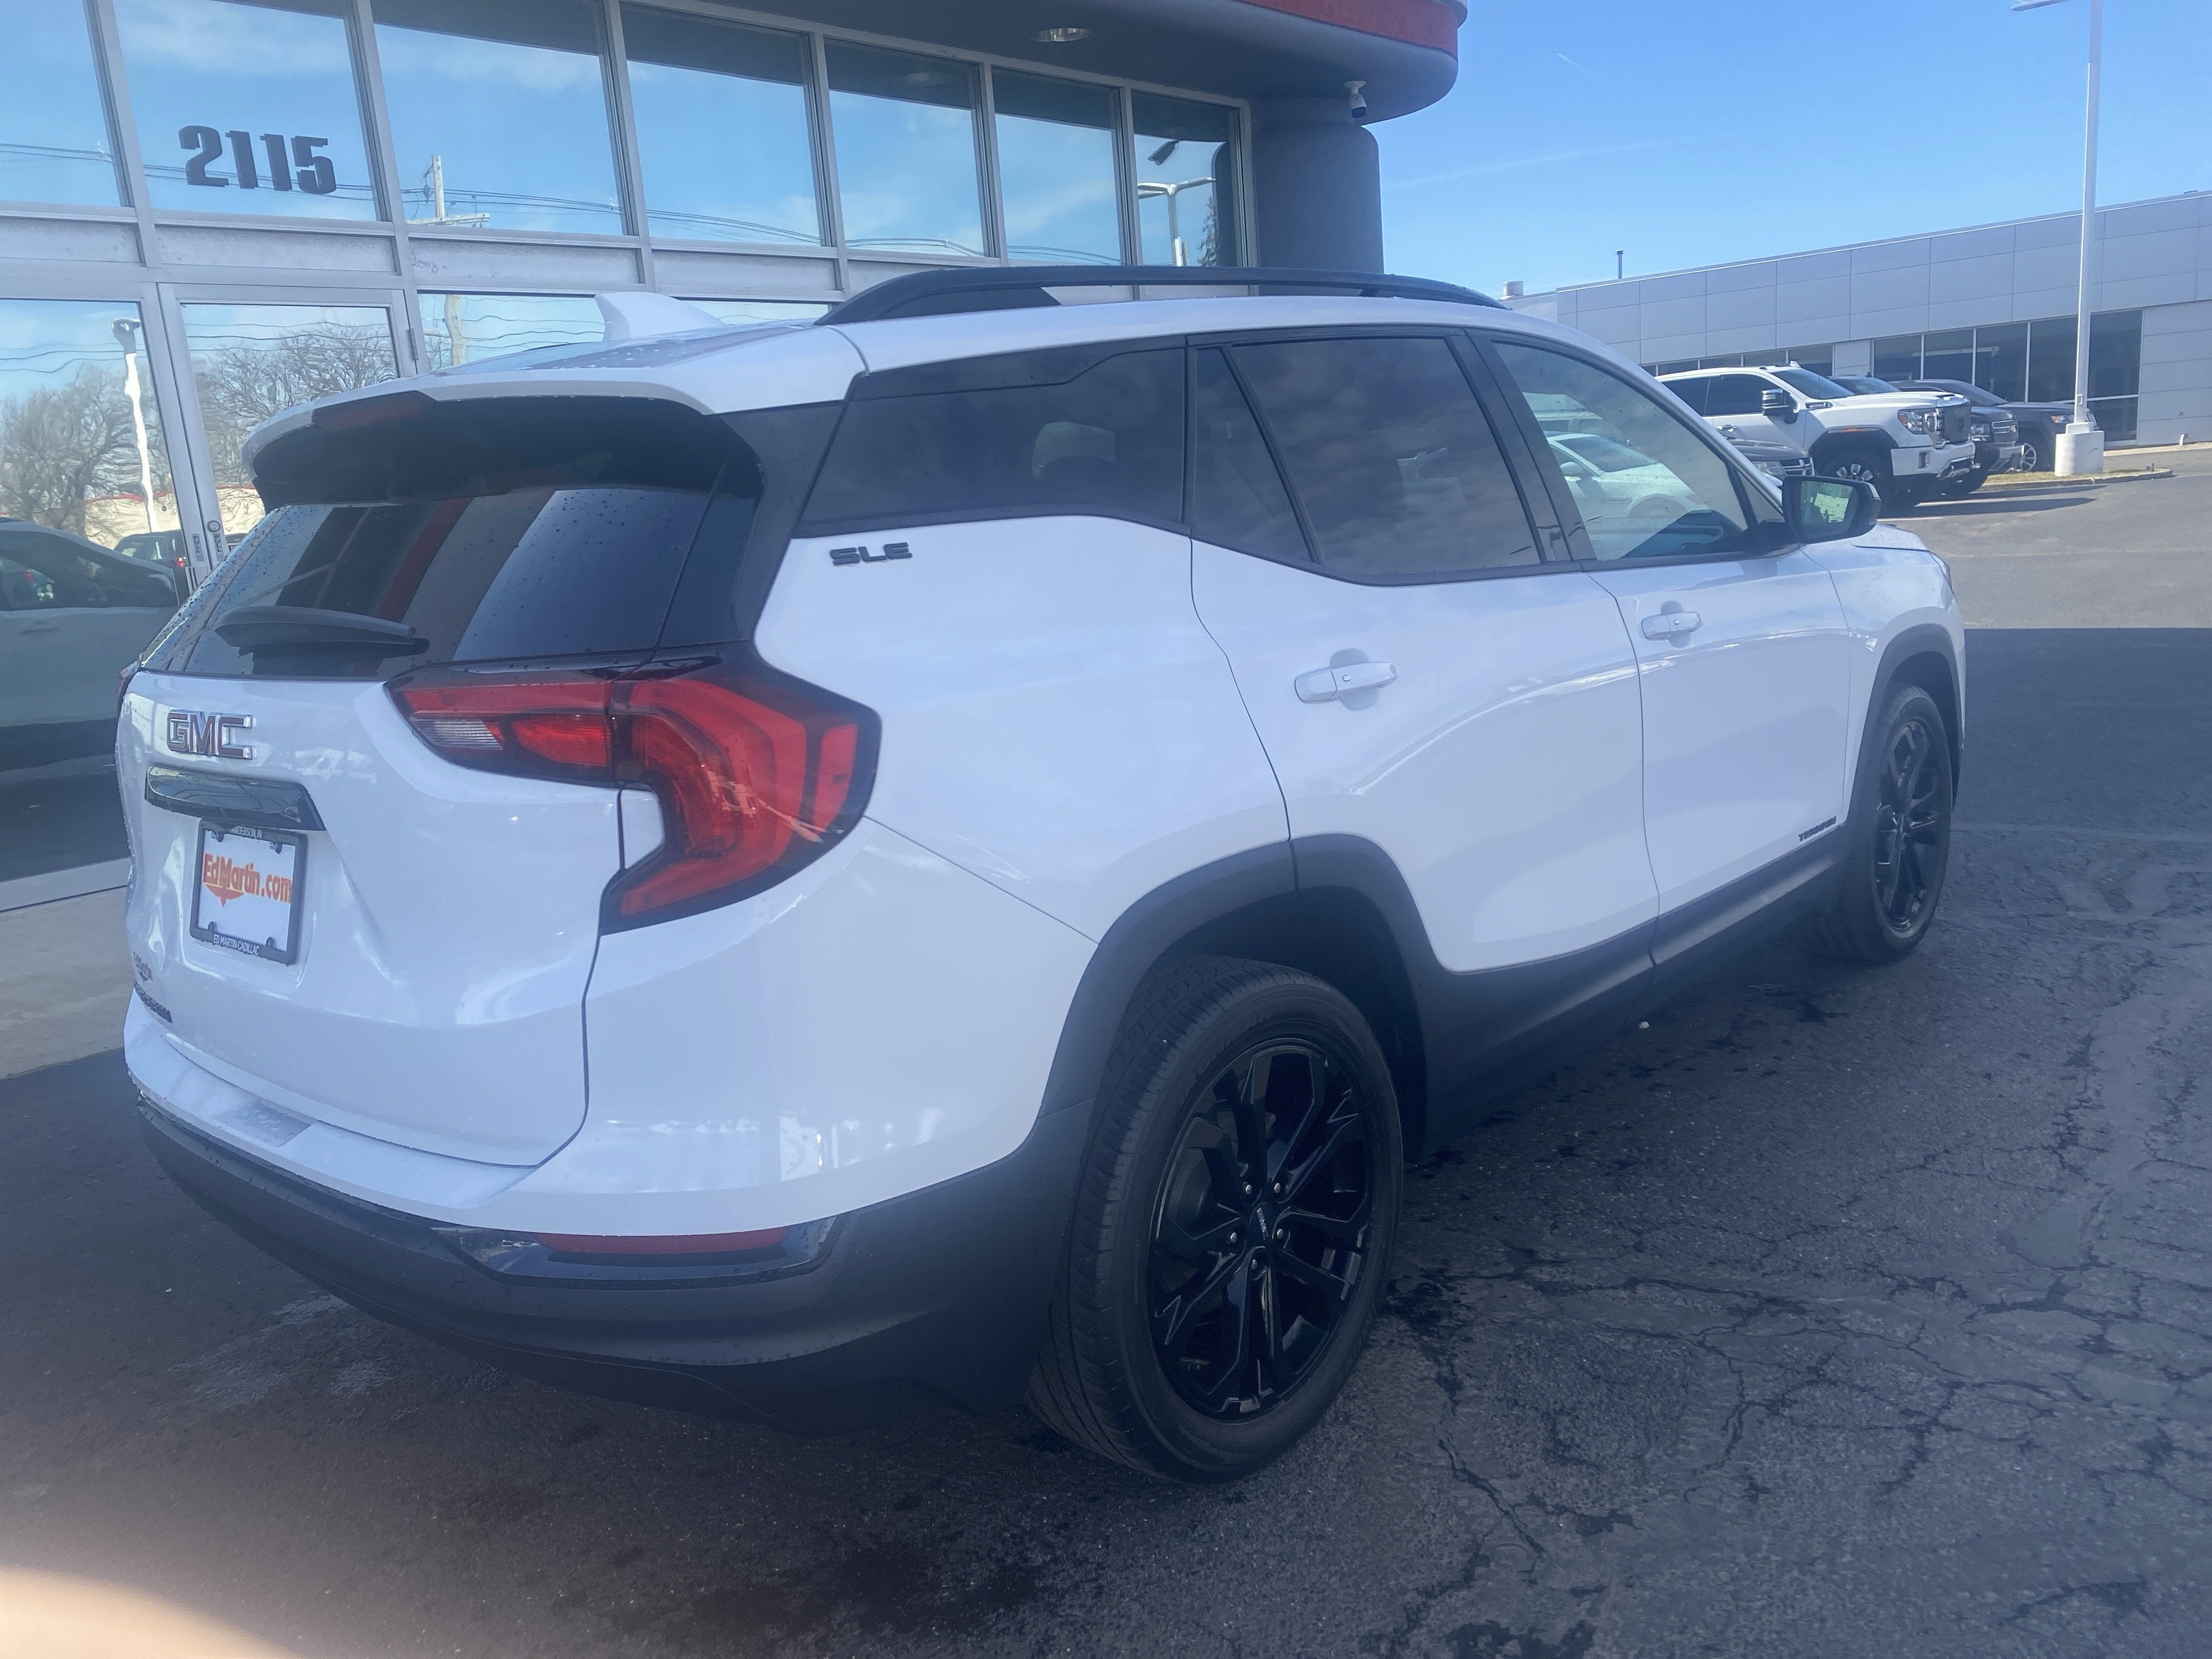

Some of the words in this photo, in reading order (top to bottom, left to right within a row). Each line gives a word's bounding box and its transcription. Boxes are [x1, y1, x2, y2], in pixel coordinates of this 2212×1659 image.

[178, 125, 336, 195] 2115
[830, 542, 913, 566] SLE
[167, 709, 253, 760] GMC
[202, 853, 292, 904] EdMartin.com
[213, 934, 220, 944] ED
[220, 936, 238, 949] MARTIN
[238, 940, 259, 955] CADILLAC
